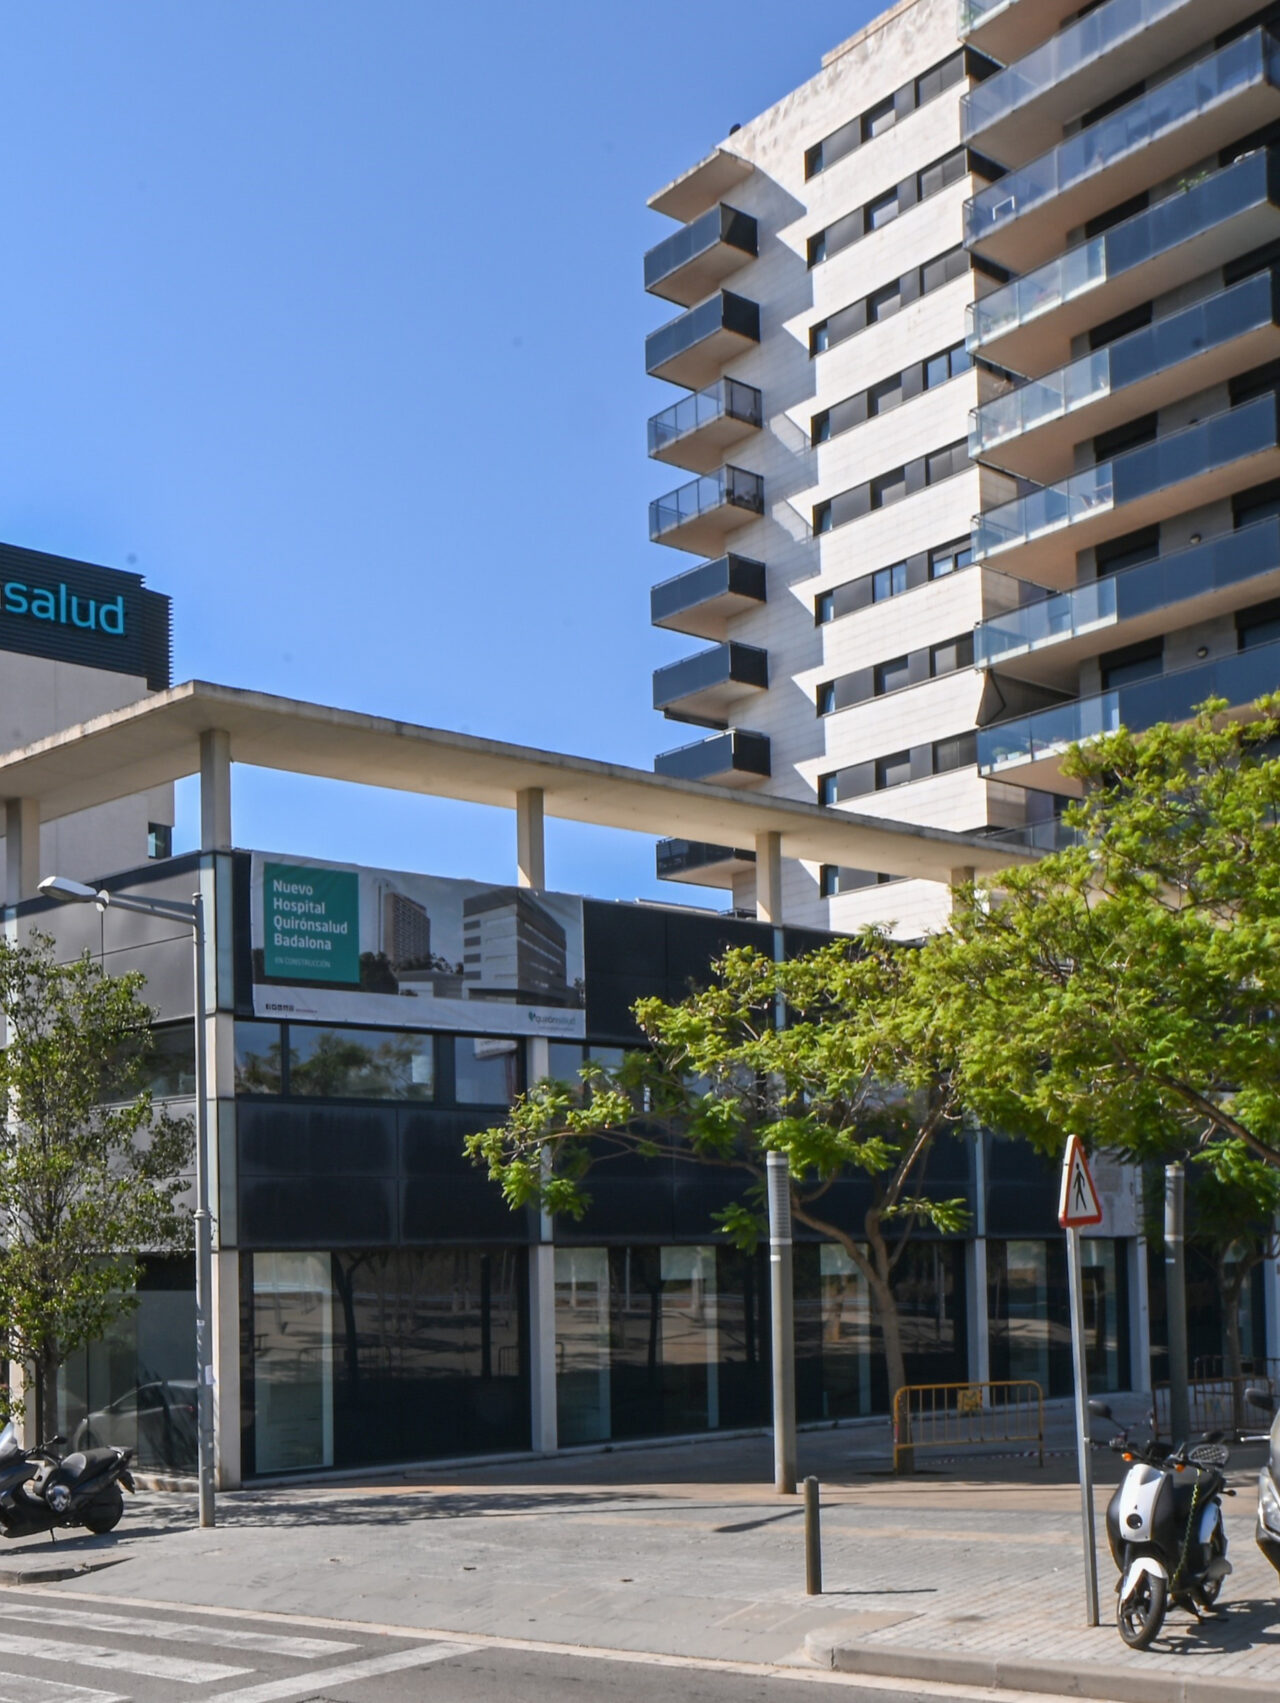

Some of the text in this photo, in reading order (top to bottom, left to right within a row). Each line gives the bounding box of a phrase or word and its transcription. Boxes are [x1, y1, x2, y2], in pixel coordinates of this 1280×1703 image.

[273, 879, 313, 895] Nuevo
[273, 898, 325, 914] Hospital
[273, 915, 348, 934] Quirónsalud
[274, 934, 331, 950] Badalona
[274, 956, 284, 965] EN
